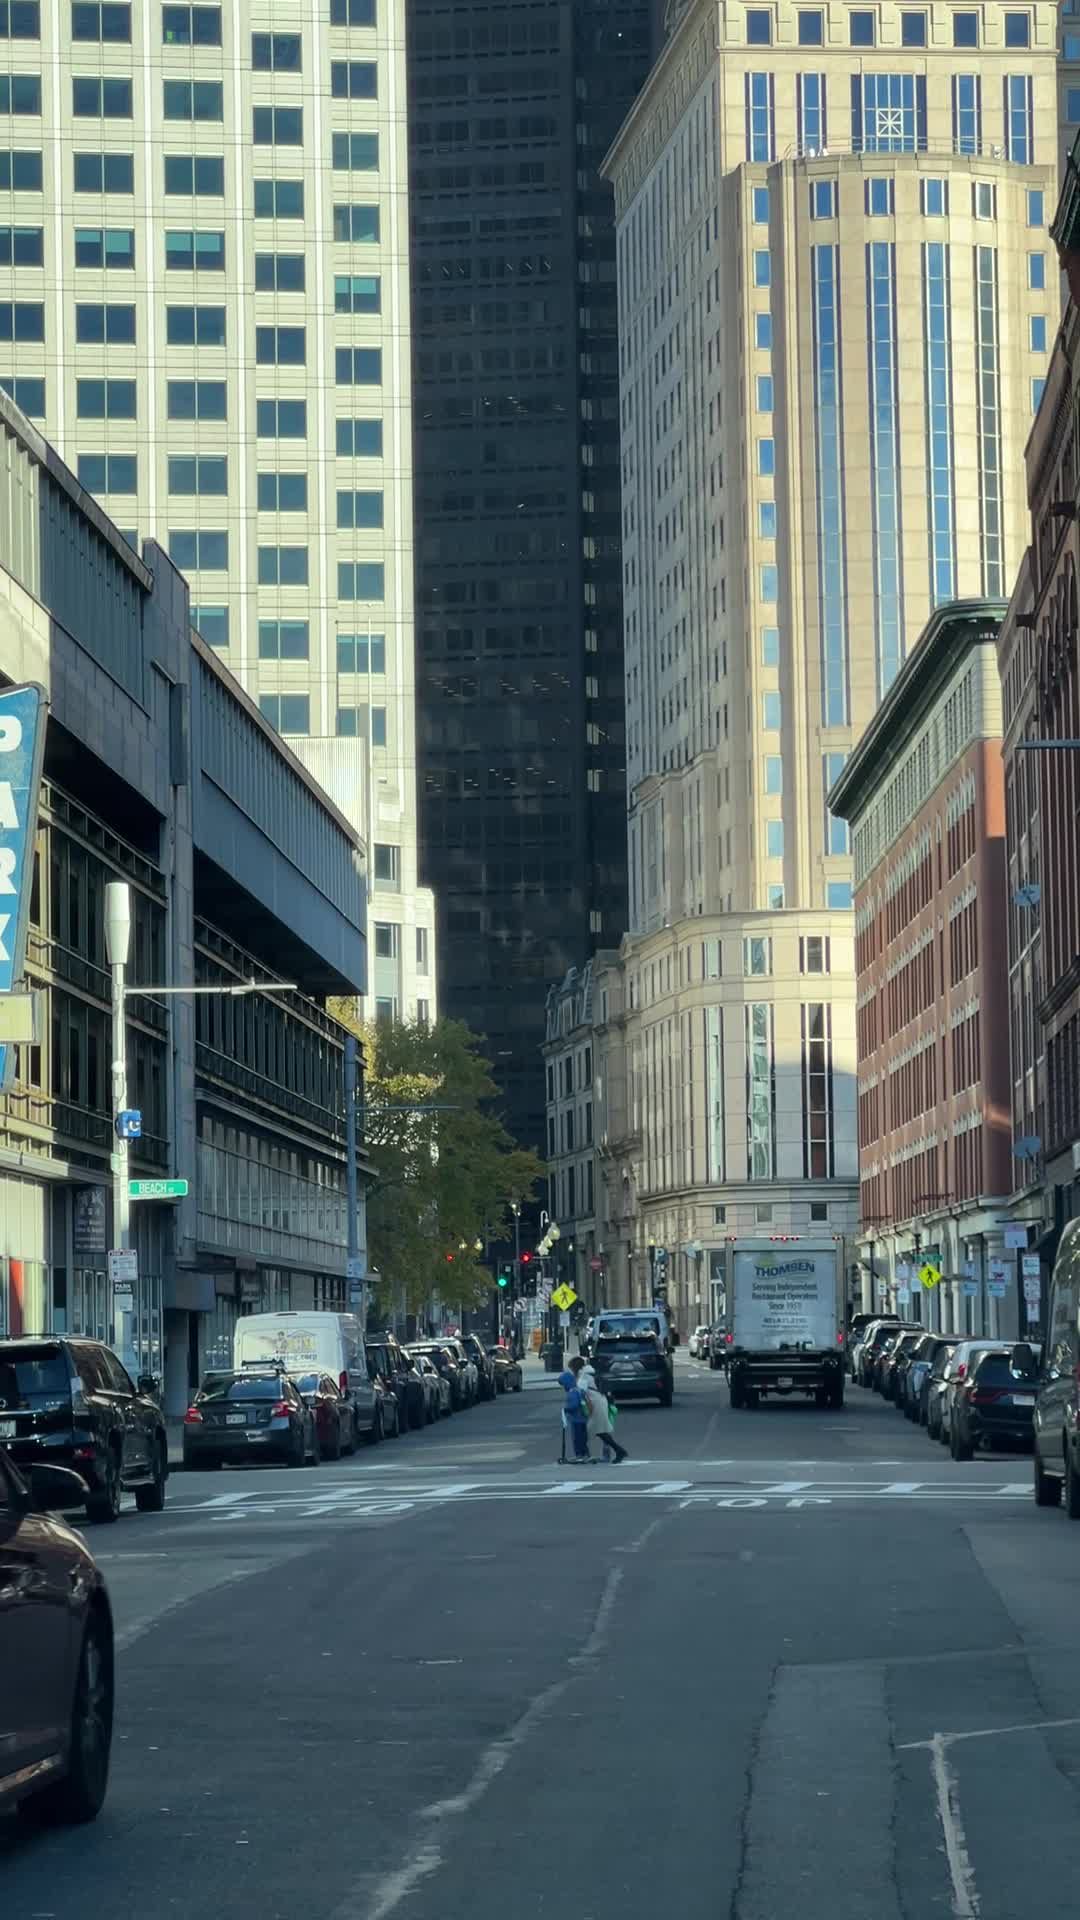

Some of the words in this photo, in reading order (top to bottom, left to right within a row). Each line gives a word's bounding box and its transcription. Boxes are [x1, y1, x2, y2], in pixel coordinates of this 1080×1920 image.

[138, 1183, 167, 1194] BEACH
[754, 1262, 815, 1276] THOMSEN
[752, 1282, 776, 1292] Serving
[777, 1282, 817, 1292] Independent
